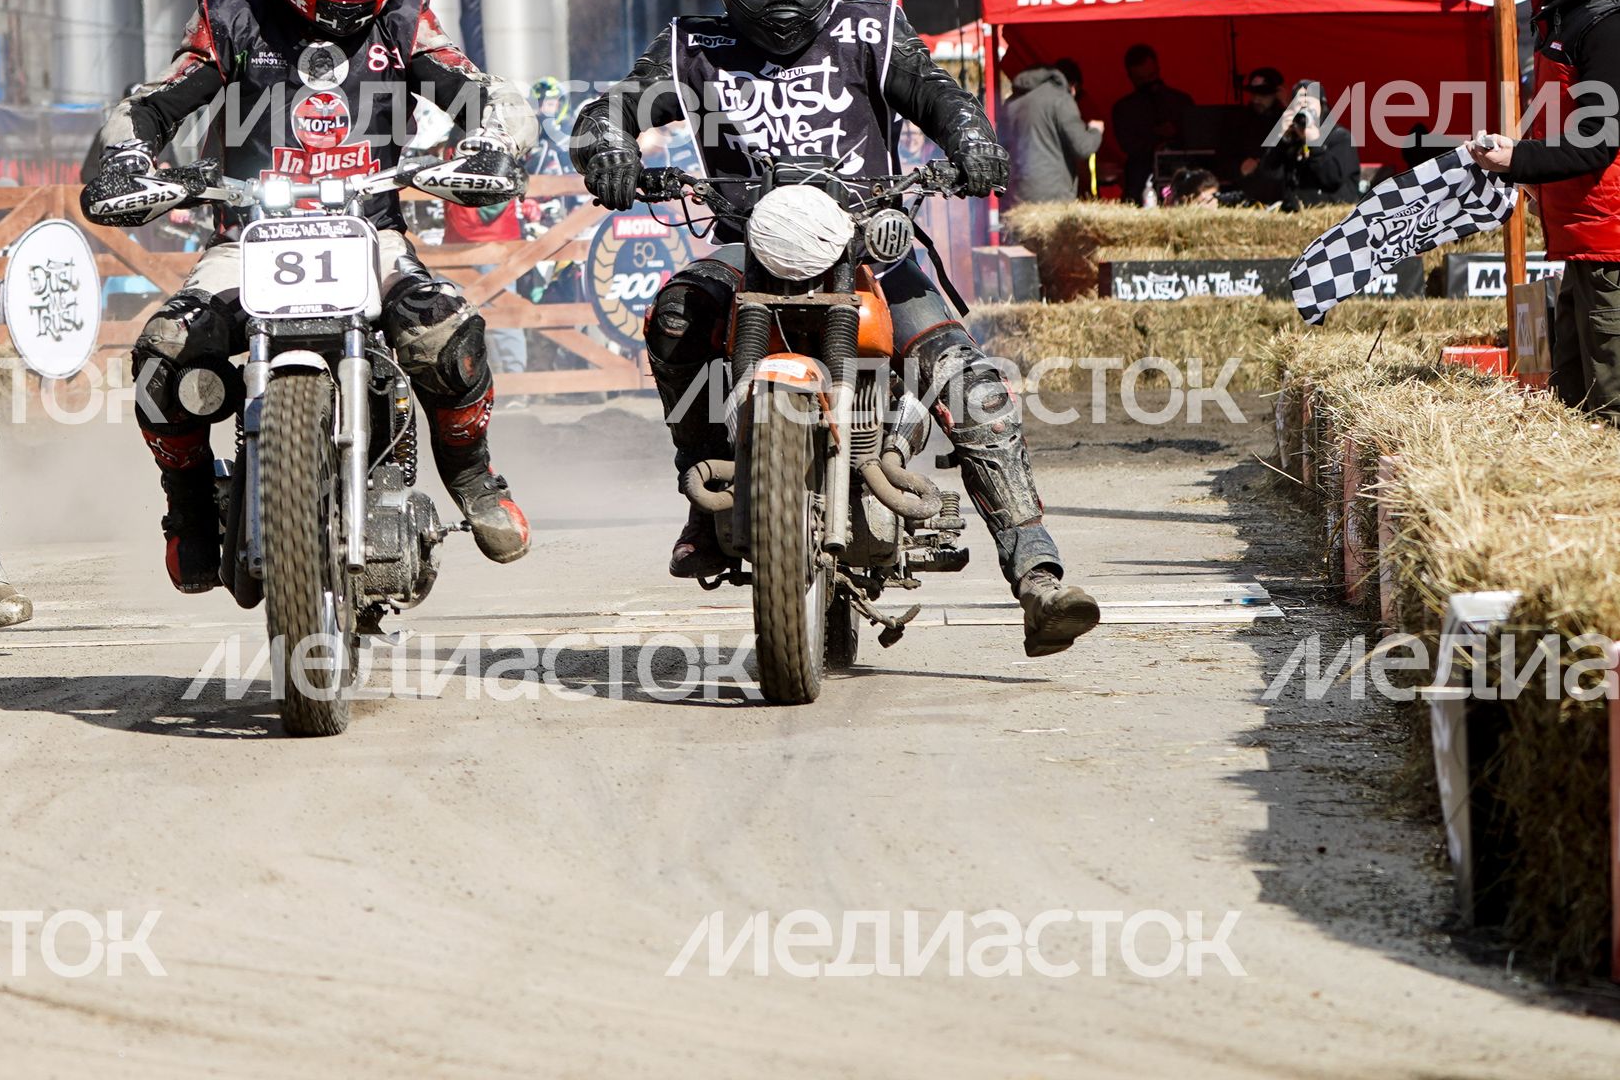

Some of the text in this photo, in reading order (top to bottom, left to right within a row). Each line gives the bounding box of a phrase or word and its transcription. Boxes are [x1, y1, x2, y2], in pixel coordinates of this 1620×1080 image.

[829, 17, 882, 44] 46
[367, 43, 406, 71] 81
[766, 66, 807, 79] MOTUL
[279, 148, 367, 176] In Dust
[422, 175, 504, 190] ACERBIS
[99, 190, 179, 215] ACERBIS
[269, 223, 301, 239] Dust
[617, 218, 668, 236] MOTUL
[273, 250, 339, 286] 81
[1132, 271, 1184, 301] Dust
